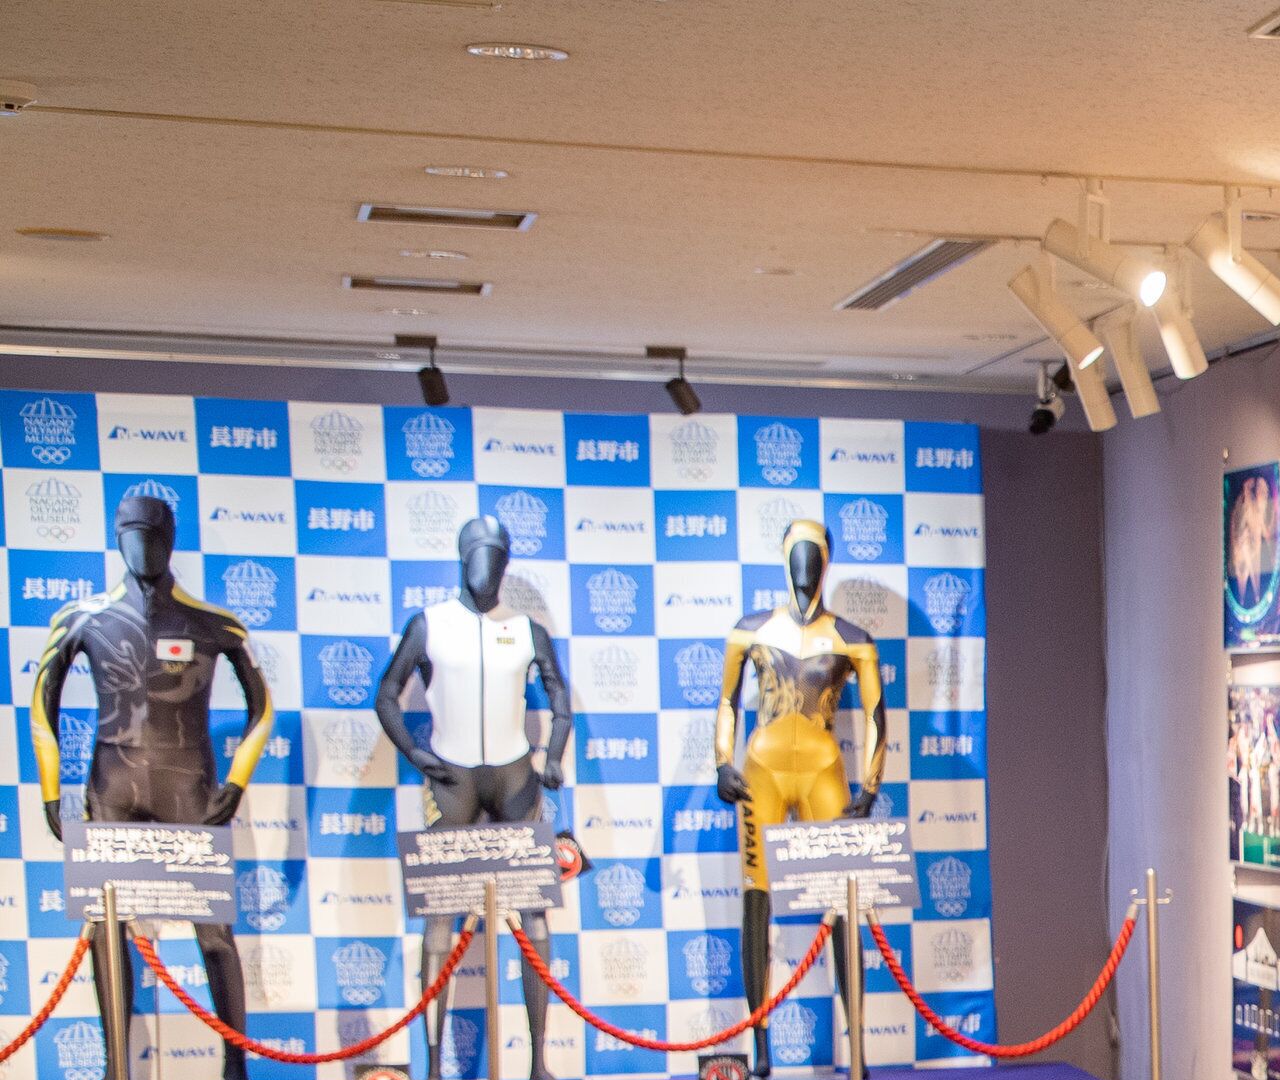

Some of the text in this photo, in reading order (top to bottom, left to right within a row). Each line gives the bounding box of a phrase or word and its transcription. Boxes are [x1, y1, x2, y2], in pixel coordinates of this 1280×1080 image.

[209, 426, 278, 450] 長野市
[576, 439, 640, 463] 長野市
[915, 447, 975, 470] 長野市
[307, 507, 376, 532] 長野市
[665, 514, 728, 537] 長野市
[22, 577, 93, 600] 長野市
[585, 737, 649, 760] 長野市
[919, 735, 973, 757] 長野市
[319, 811, 387, 836] 長野市
[673, 809, 735, 832] 長野市
